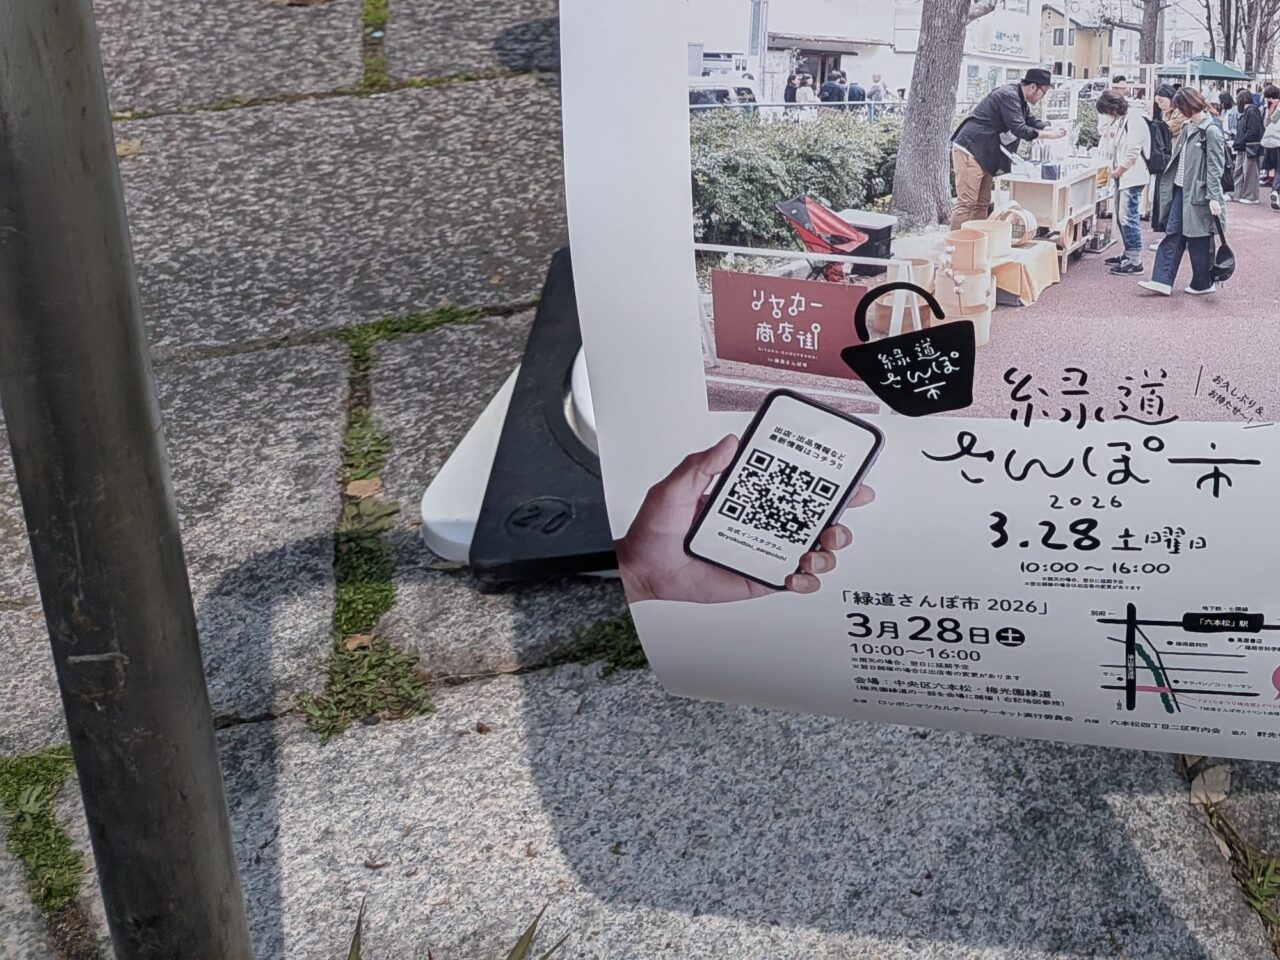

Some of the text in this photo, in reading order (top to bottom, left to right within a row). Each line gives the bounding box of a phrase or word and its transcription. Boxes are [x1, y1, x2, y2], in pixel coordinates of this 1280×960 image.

[751, 289, 824, 319] リヤカー
[756, 321, 821, 351] 商店街
[1003, 367, 1180, 430] 緑道
[774, 426, 847, 462] 出店・出品情報など
[1049, 495, 1123, 510] 2026
[726, 525, 783, 551] 公式インスタグラム
[988, 510, 1101, 552] 3.28
